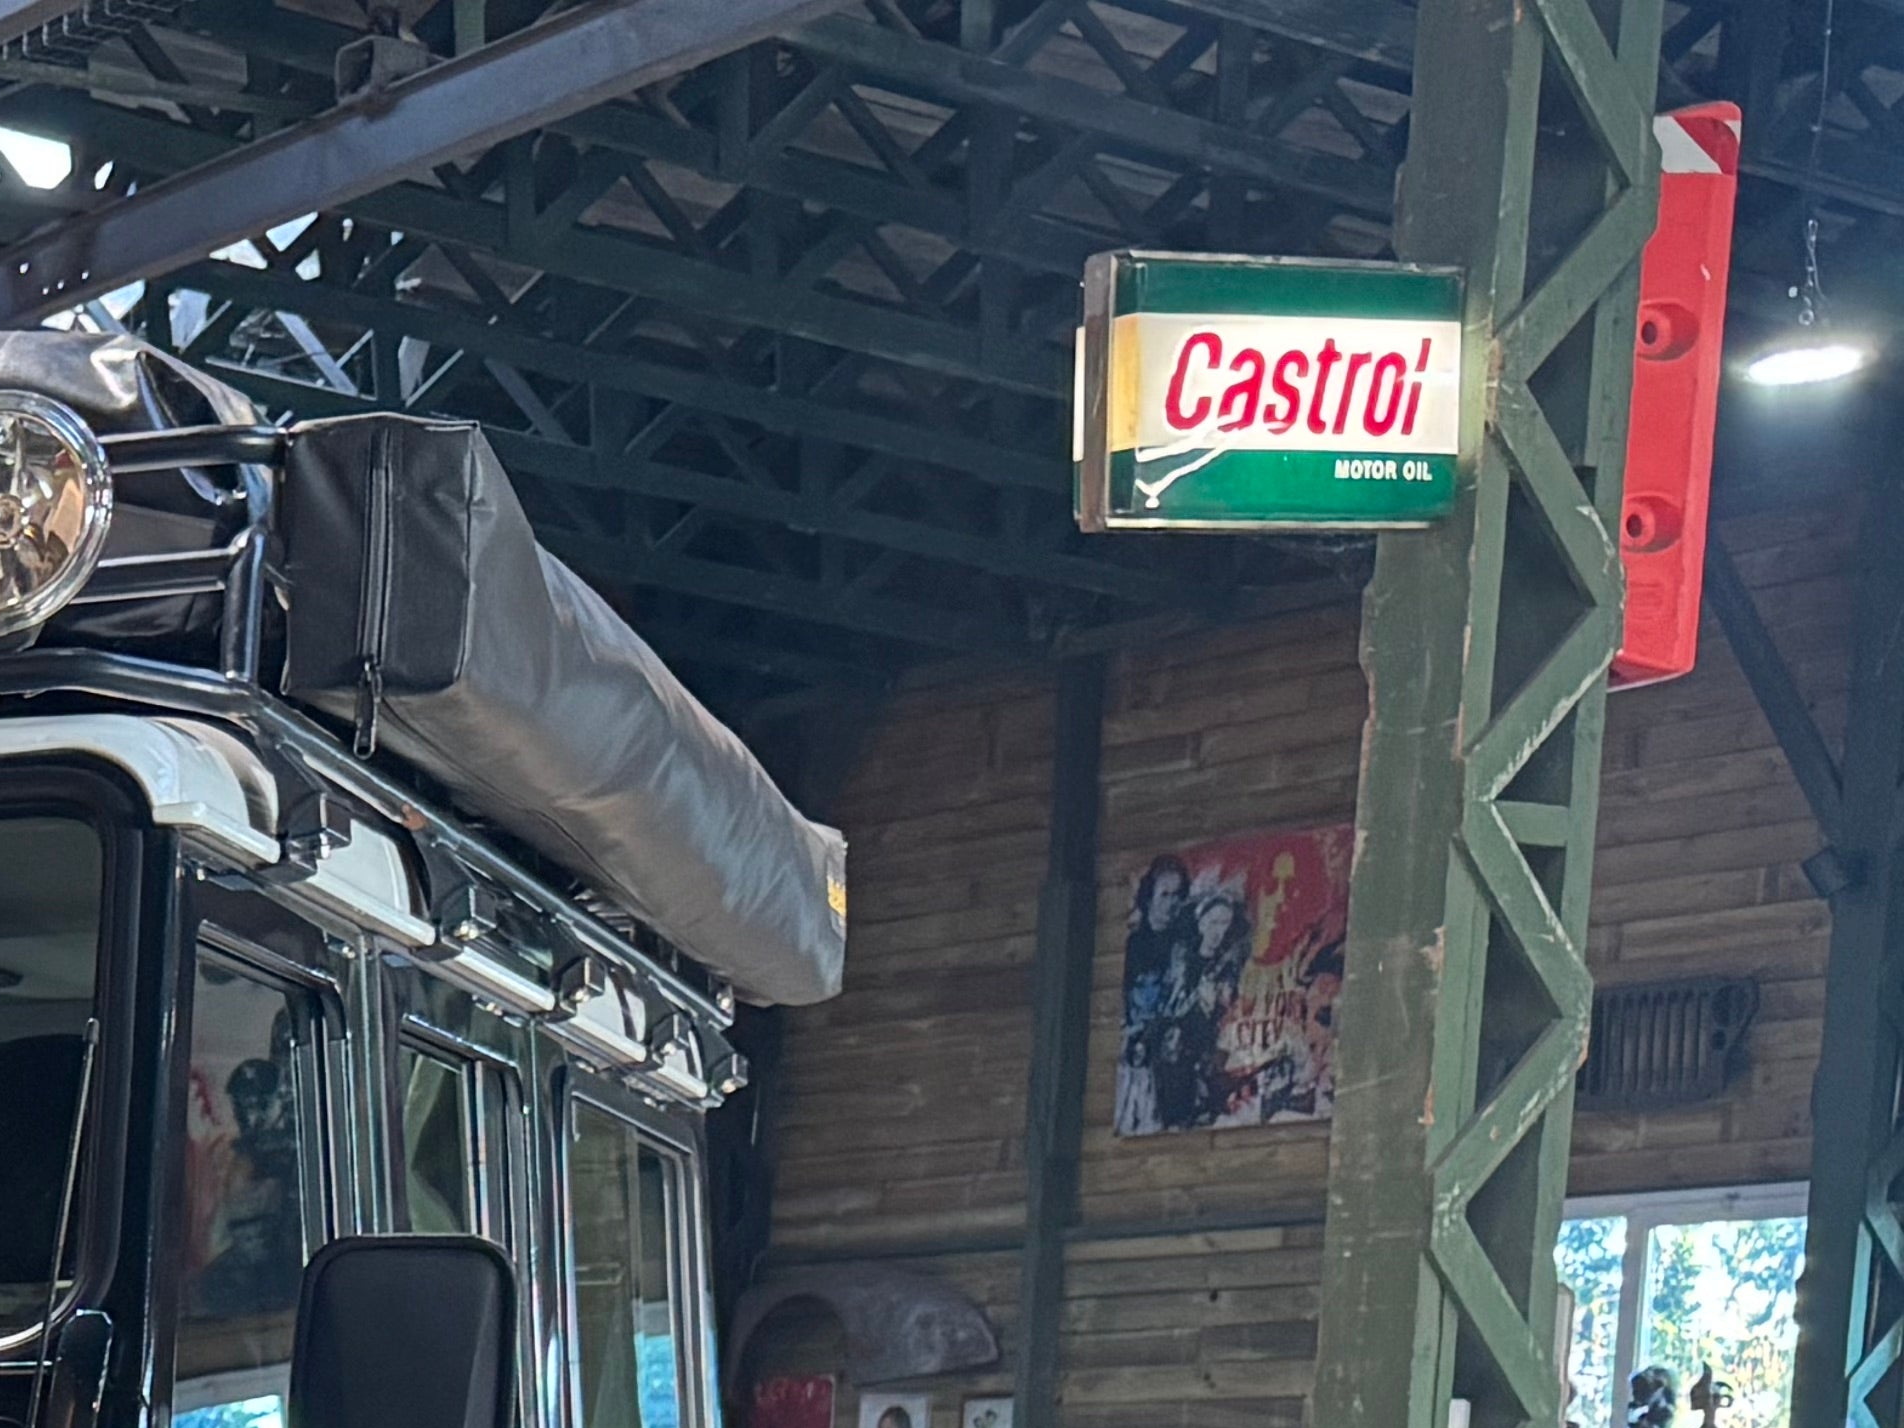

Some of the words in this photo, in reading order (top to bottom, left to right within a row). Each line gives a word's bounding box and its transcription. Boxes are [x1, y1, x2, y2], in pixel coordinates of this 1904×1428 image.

[1165, 331, 1433, 437] Castrol
[1334, 459, 1398, 480] MOTOR
[1402, 460, 1434, 481] OIL
